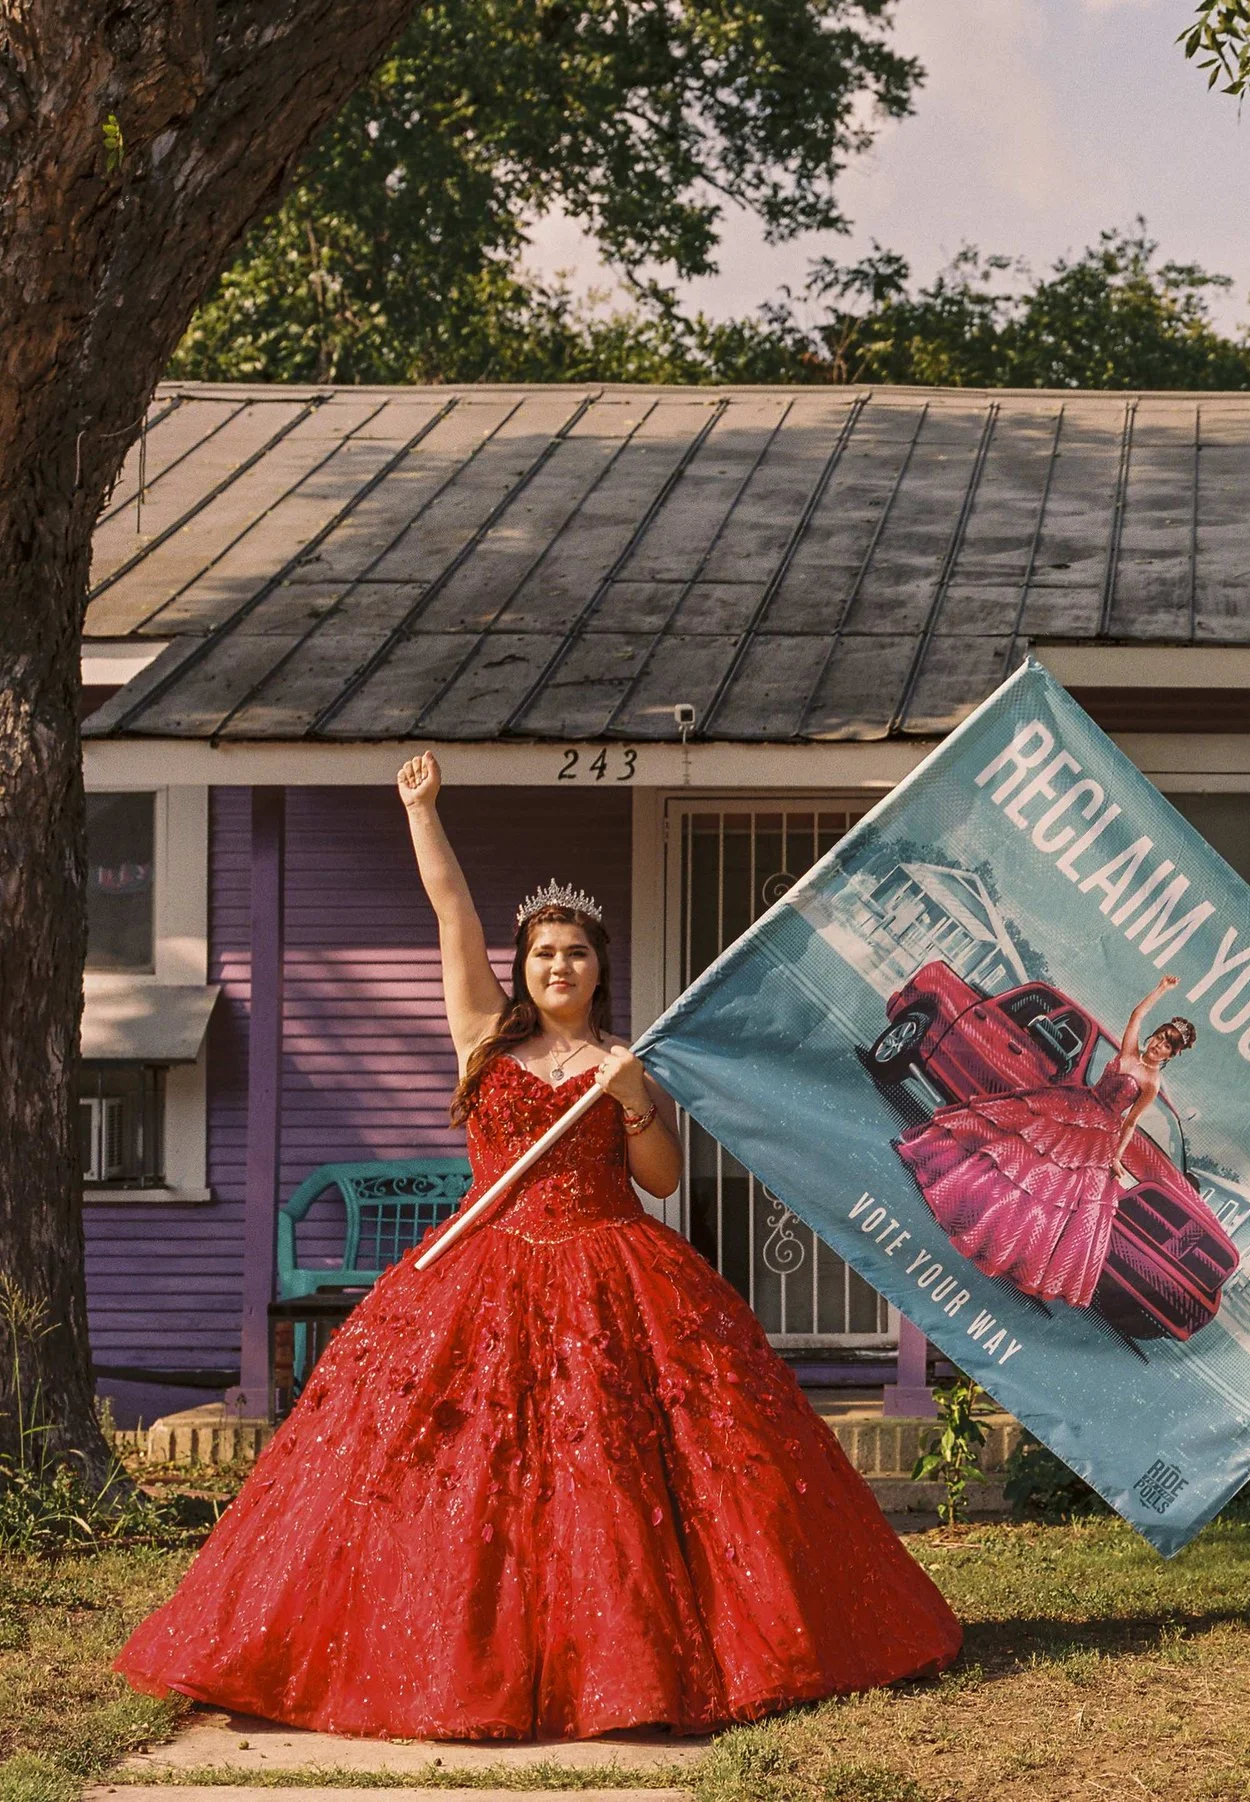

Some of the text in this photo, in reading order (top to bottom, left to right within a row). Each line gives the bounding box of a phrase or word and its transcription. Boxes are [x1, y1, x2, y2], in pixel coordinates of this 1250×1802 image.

[558, 747, 637, 780] 243
[975, 719, 1215, 969] RECLAIM
[848, 1191, 1022, 1364] VOTE YOUR WAY
[1133, 1479, 1170, 1514] POLLS
[1147, 1459, 1189, 1497] RIDE
